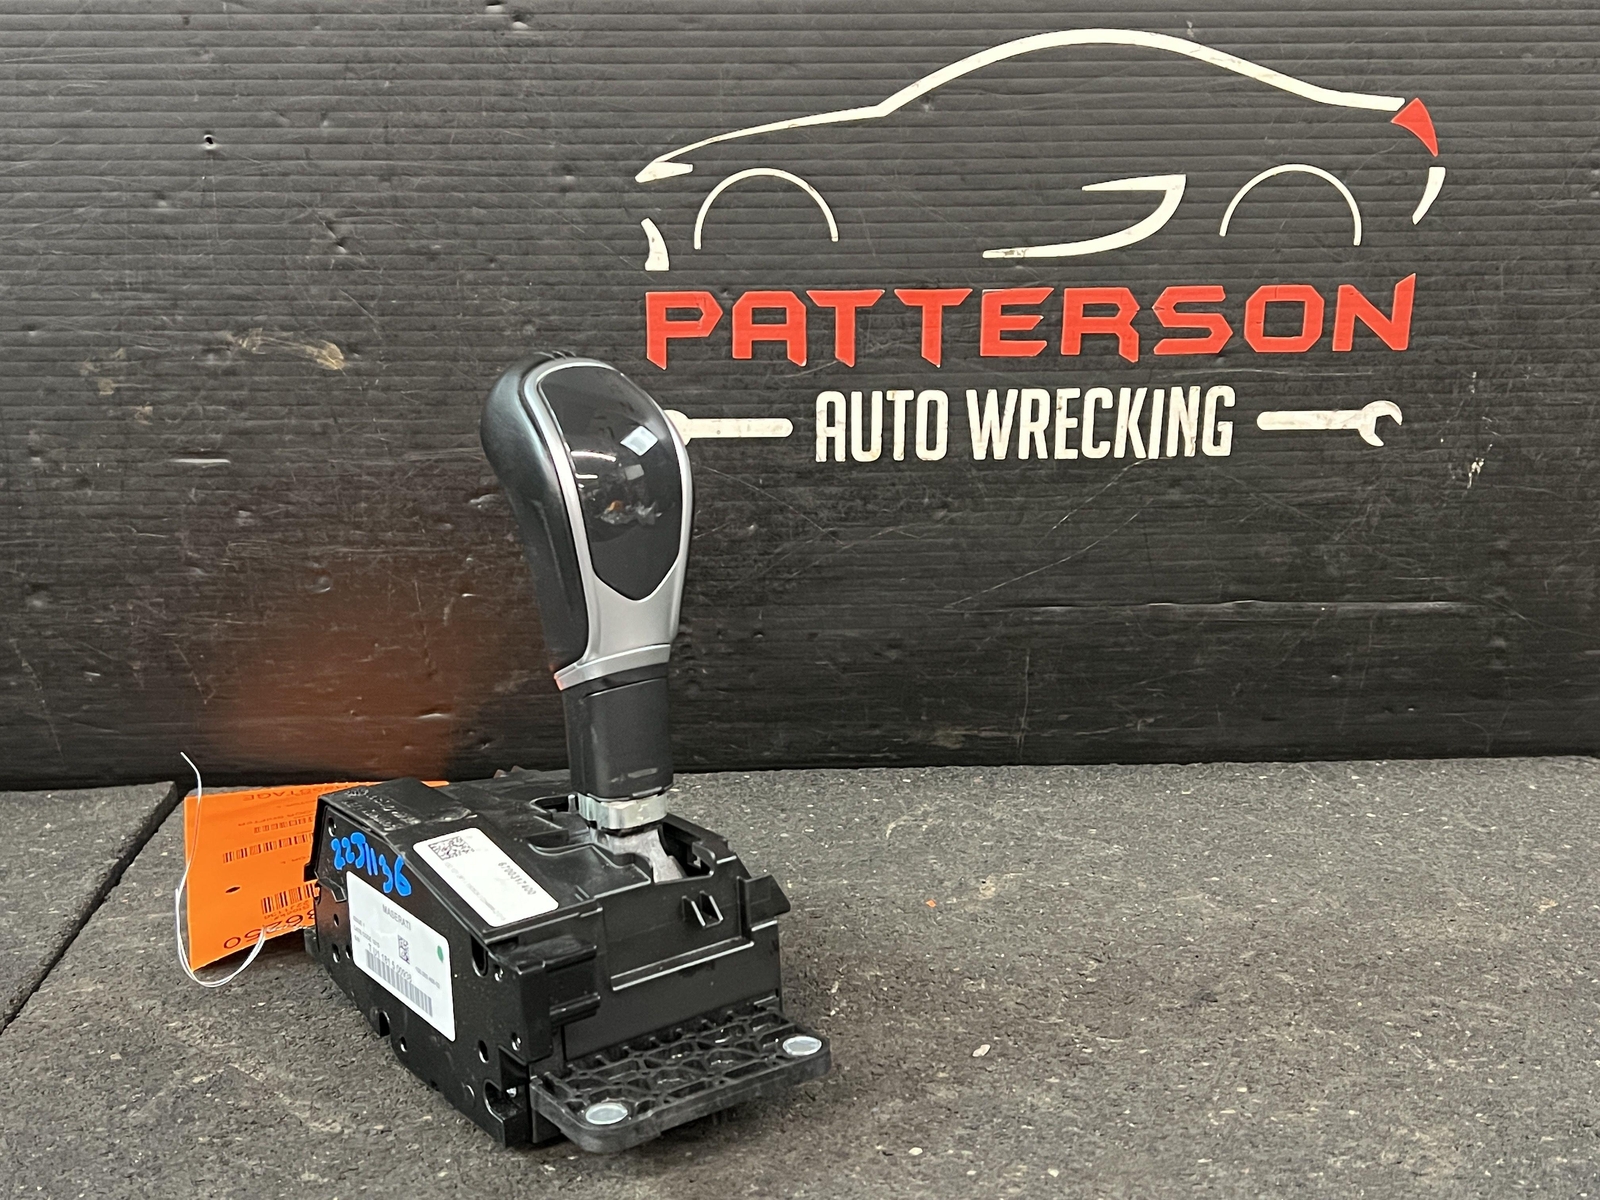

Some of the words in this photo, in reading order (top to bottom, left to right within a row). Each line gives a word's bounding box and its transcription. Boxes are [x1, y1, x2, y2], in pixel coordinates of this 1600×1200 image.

[645, 273, 1416, 370] PATTERSON
[815, 389, 948, 463] AUTO
[966, 384, 1236, 462] WRECKING
[382, 903, 411, 931] MASERATI
